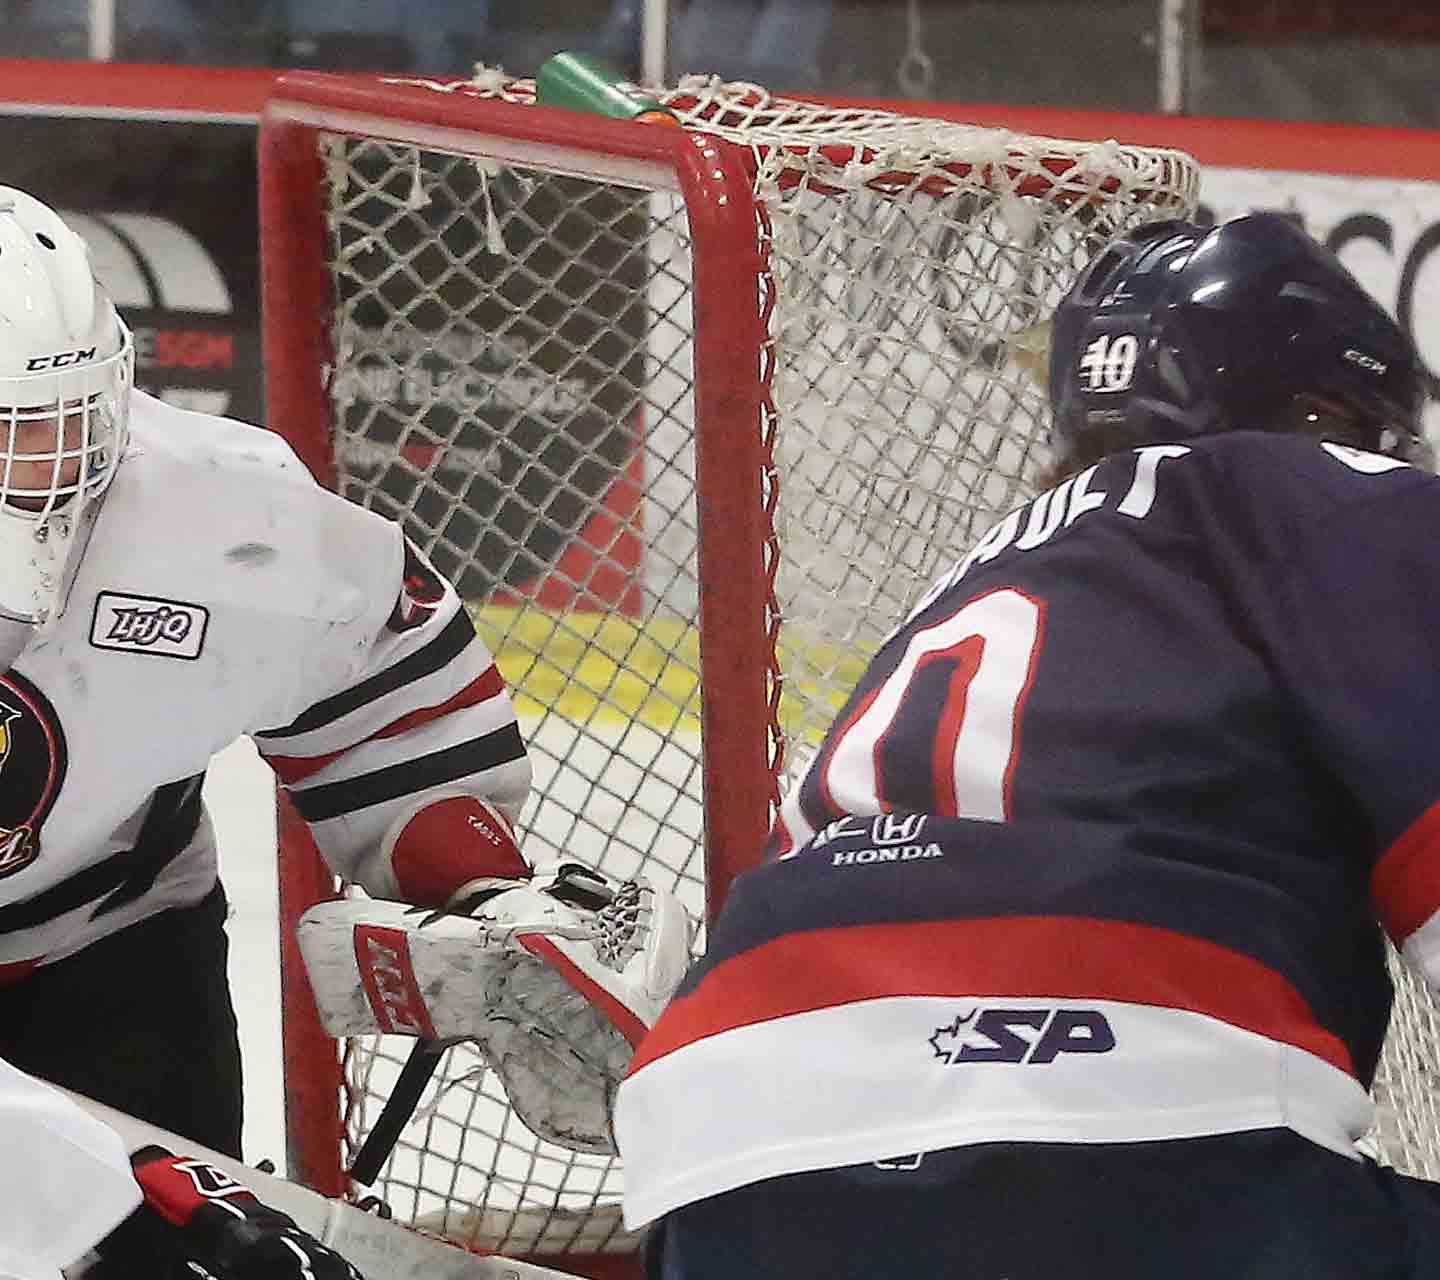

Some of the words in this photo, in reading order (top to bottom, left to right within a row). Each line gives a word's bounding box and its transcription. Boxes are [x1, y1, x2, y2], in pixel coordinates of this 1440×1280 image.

[25, 346, 97, 372] CCM
[1078, 333, 1138, 394] 10
[831, 842, 944, 867] HONDA
